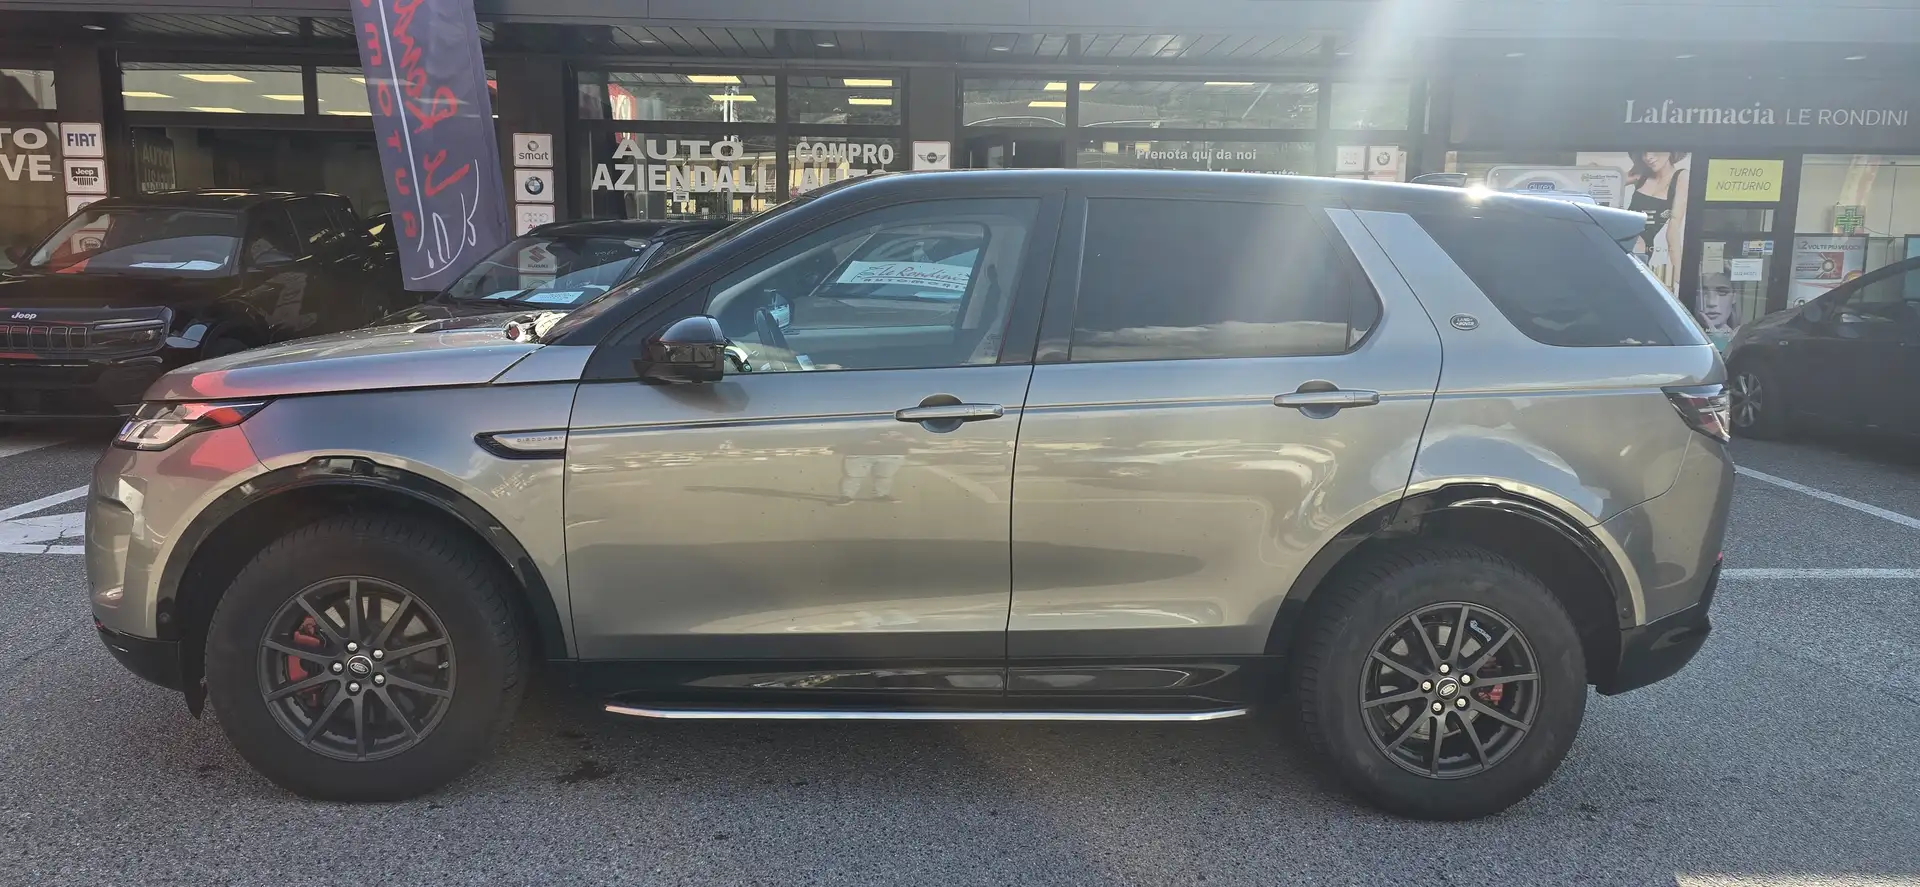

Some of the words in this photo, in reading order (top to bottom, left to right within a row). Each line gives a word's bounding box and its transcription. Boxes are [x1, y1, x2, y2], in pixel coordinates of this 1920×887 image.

[1624, 99, 1775, 126] Lafarmacia
[1785, 108, 1812, 126] LE
[1818, 109, 1909, 127] RONDINI
[66, 133, 97, 147] FIAT
[612, 139, 744, 161] AUTO
[795, 142, 894, 165] COMPRO
[1136, 148, 1188, 160] Prenota
[1192, 148, 1212, 162] qui
[1216, 149, 1232, 160] da
[1236, 149, 1257, 160] noi
[518, 152, 549, 161] smart
[75, 168, 94, 176] Jeep
[591, 163, 767, 193] AZIENDALI
[1728, 167, 1764, 178] TURNO
[1528, 182, 1553, 190] durex
[1715, 180, 1772, 192] NOTTURNO
[11, 311, 37, 321] Jeep
[516, 435, 564, 443] DISCOVERY
